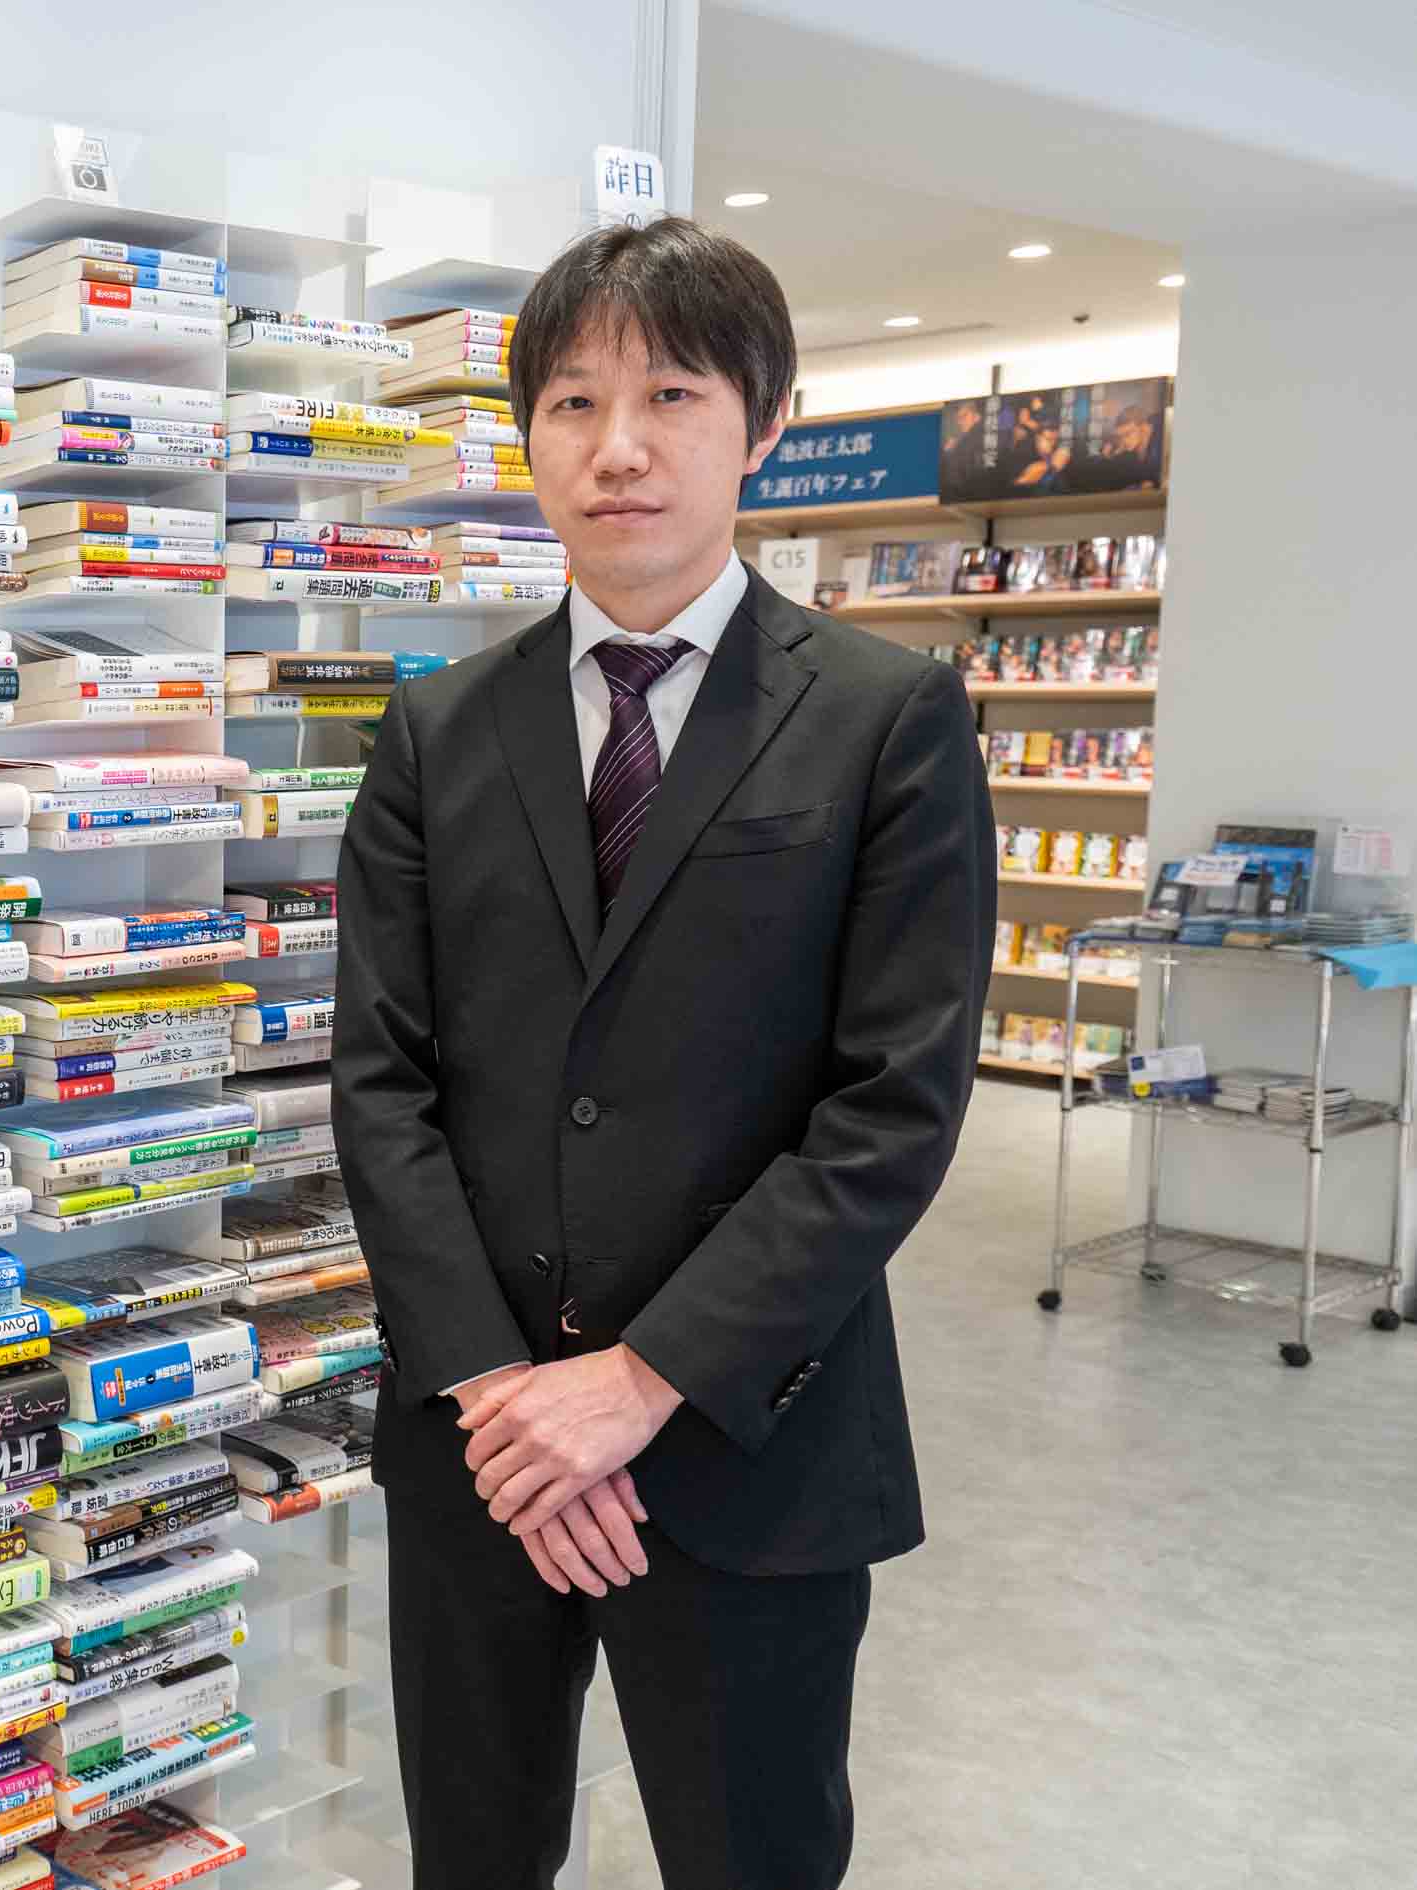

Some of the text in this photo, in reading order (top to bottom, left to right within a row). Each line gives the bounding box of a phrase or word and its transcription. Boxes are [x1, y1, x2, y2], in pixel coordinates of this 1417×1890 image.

[295, 399, 333, 419] FIRE
[306, 576, 372, 599] 過去問題集
[91, 1010, 173, 1034] やり続ける力
